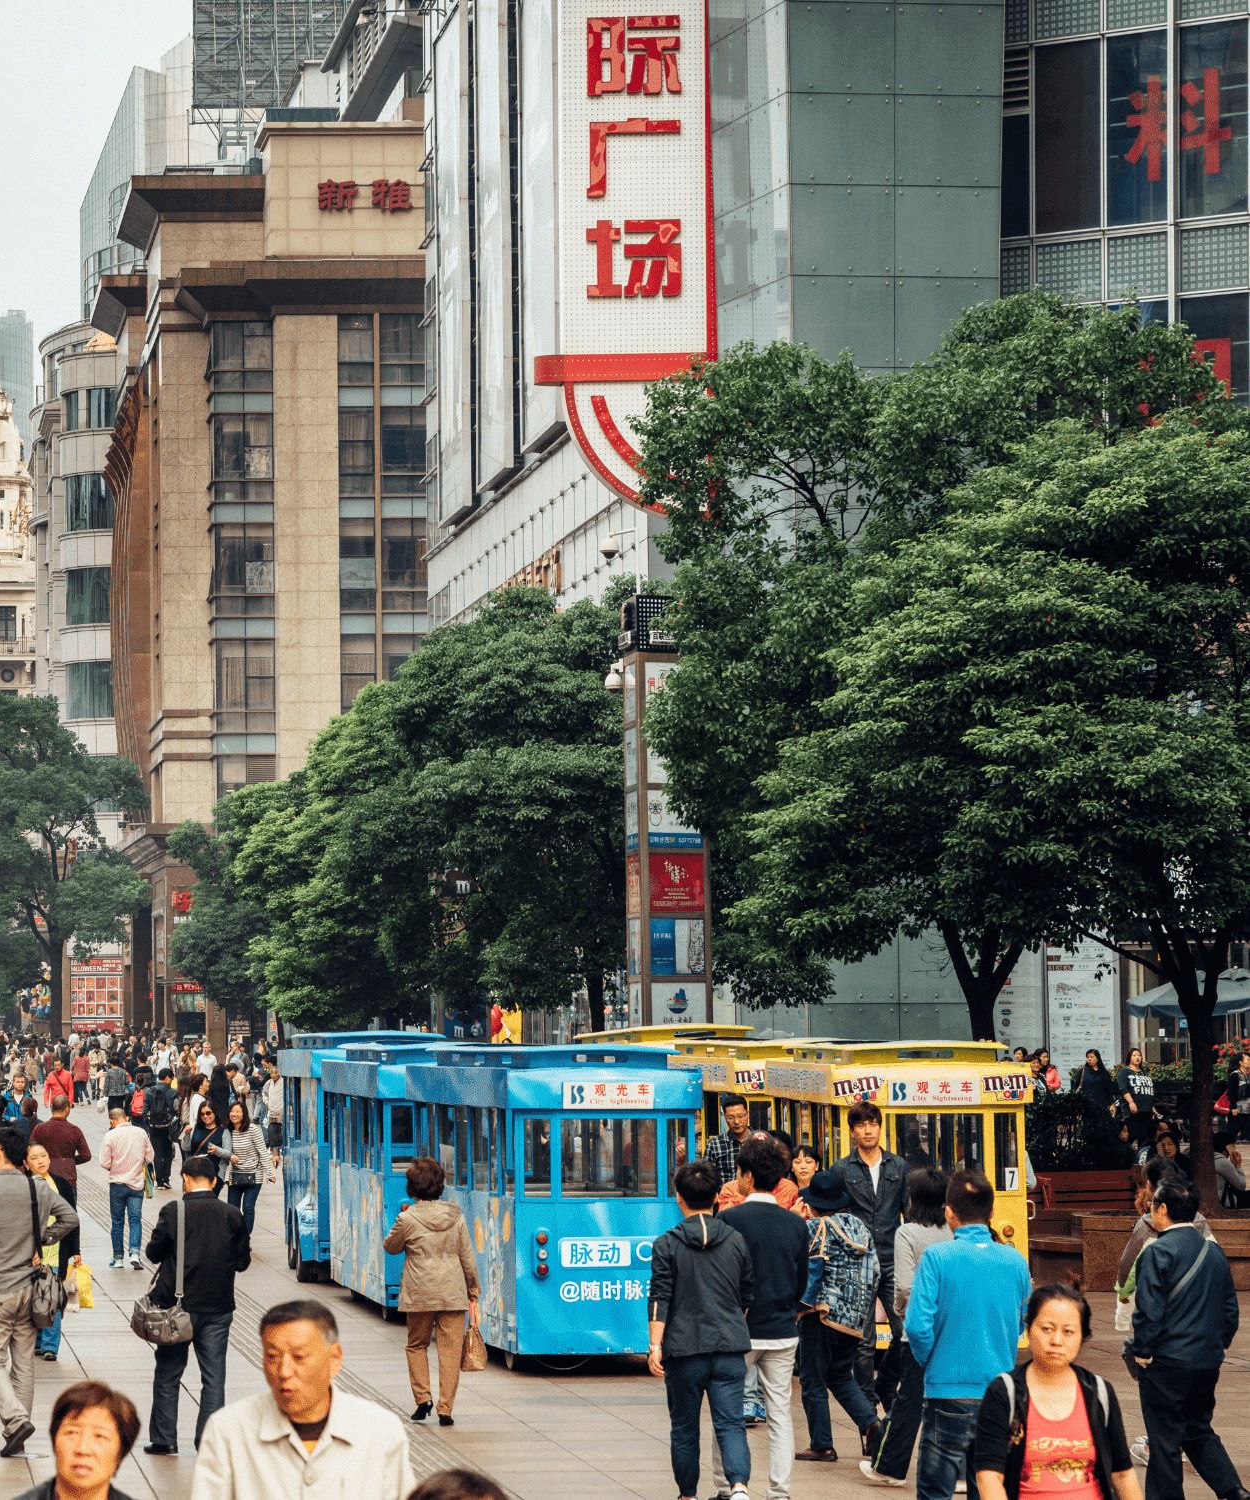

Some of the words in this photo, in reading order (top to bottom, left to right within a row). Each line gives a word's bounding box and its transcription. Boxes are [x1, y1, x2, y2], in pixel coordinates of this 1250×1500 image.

[1125, 67, 1233, 182] 料
[317, 178, 414, 212] 新雅
[594, 1083, 650, 1097] 观光车
[916, 1081, 973, 1094] 观光车
[912, 1095, 927, 1103] City
[932, 1095, 973, 1103] Sightseeing
[1008, 1171, 1016, 1188] 7
[570, 1242, 621, 1265] 脉动
[560, 1279, 652, 1302] @随时脉
